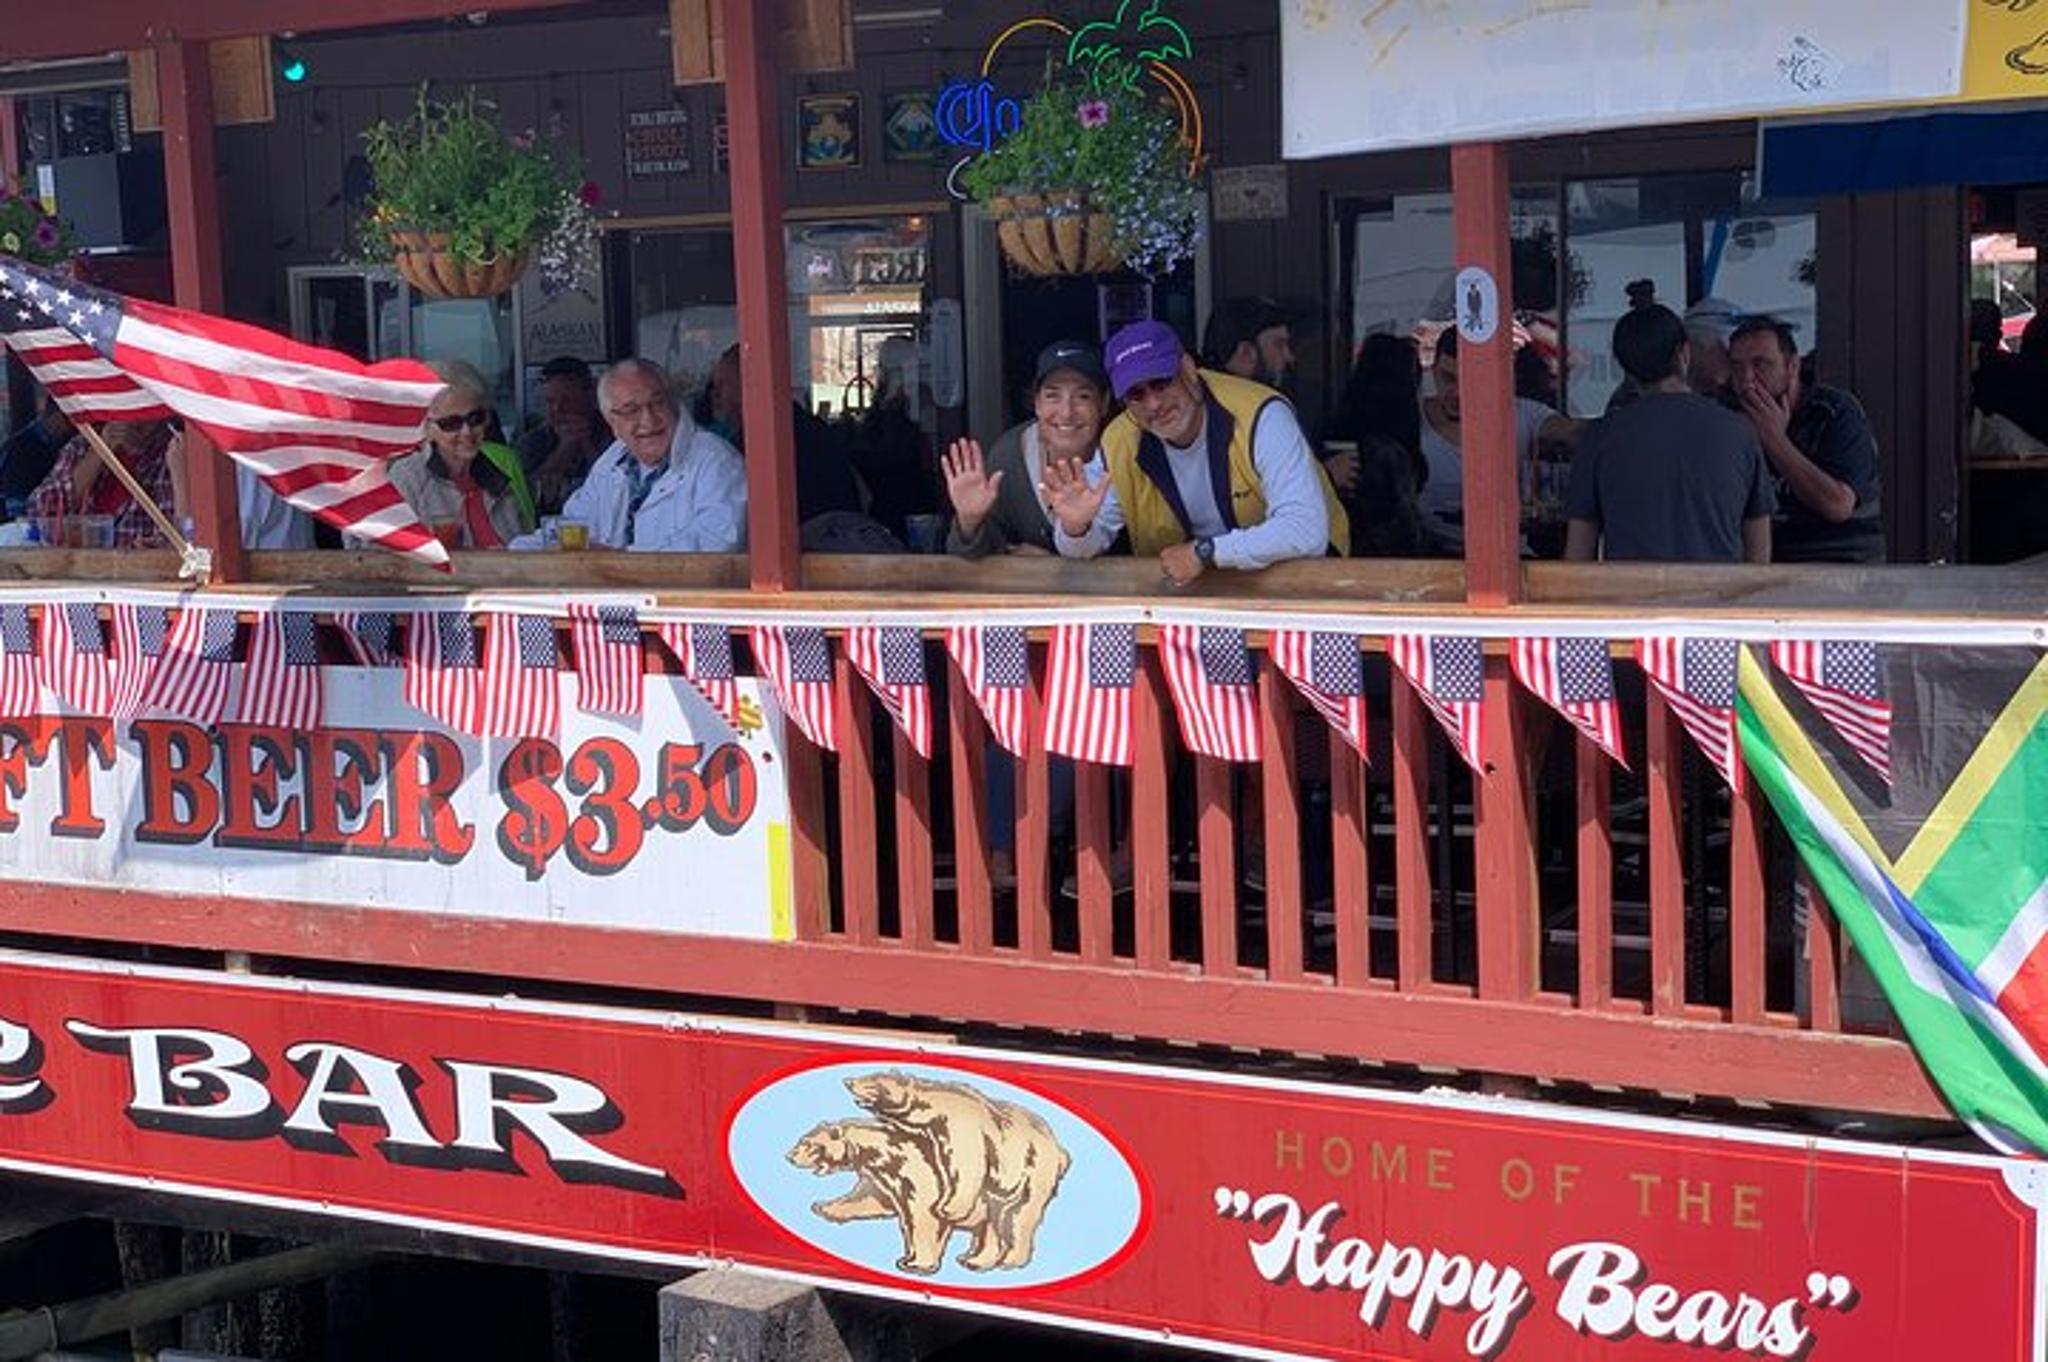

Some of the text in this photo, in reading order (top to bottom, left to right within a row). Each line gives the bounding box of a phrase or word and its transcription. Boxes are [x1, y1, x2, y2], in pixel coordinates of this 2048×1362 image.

[130, 720, 475, 866] BEER
[496, 736, 757, 881] $3.50
[64, 1019, 684, 1199] BAR
[1275, 1130, 1764, 1229] HOME OF THE
